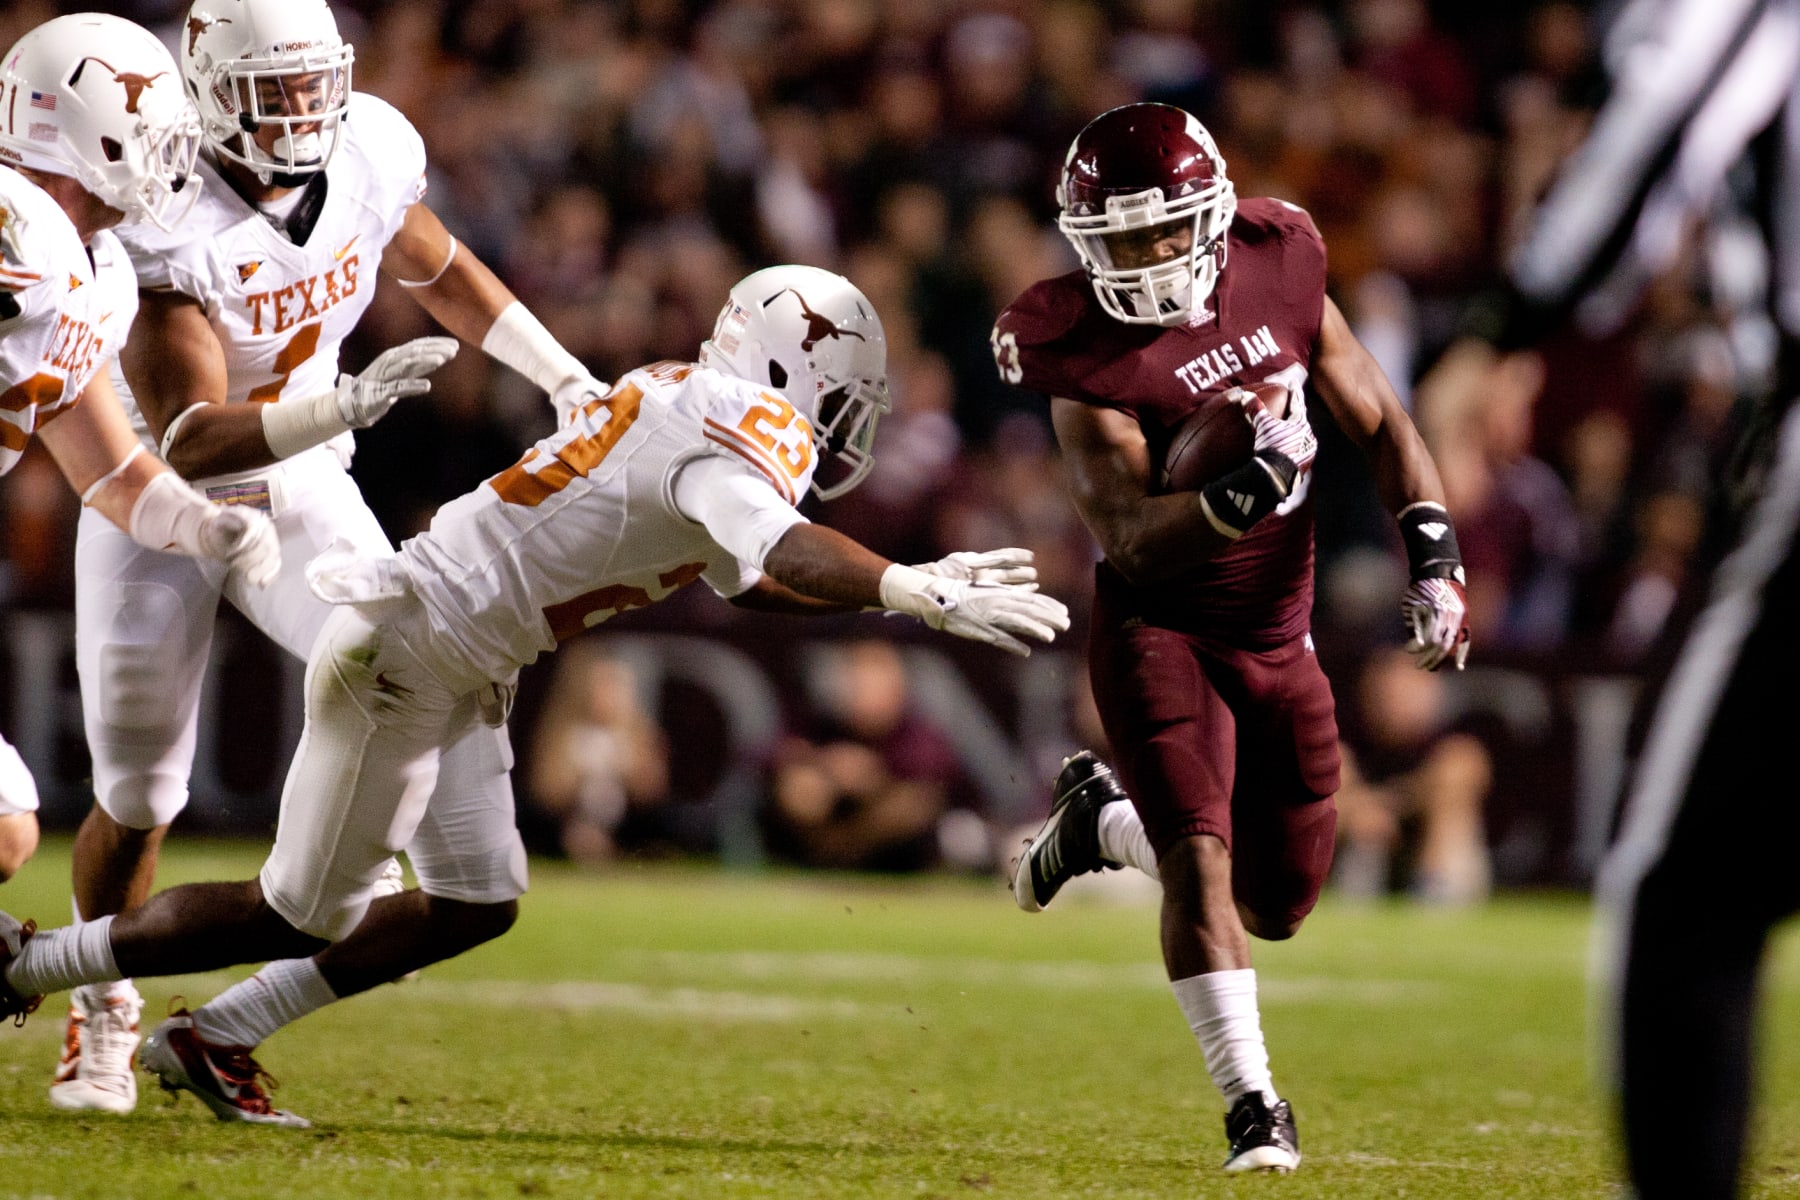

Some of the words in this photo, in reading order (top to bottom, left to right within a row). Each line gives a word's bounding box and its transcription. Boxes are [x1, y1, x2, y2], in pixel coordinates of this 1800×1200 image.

[285, 41, 312, 52] HORNS
[245, 253, 360, 337] TEXAS
[42, 312, 103, 386] TEXAS
[1174, 342, 1244, 395] TEXAS
[1239, 324, 1281, 367] A&M
[737, 390, 814, 479] 23
